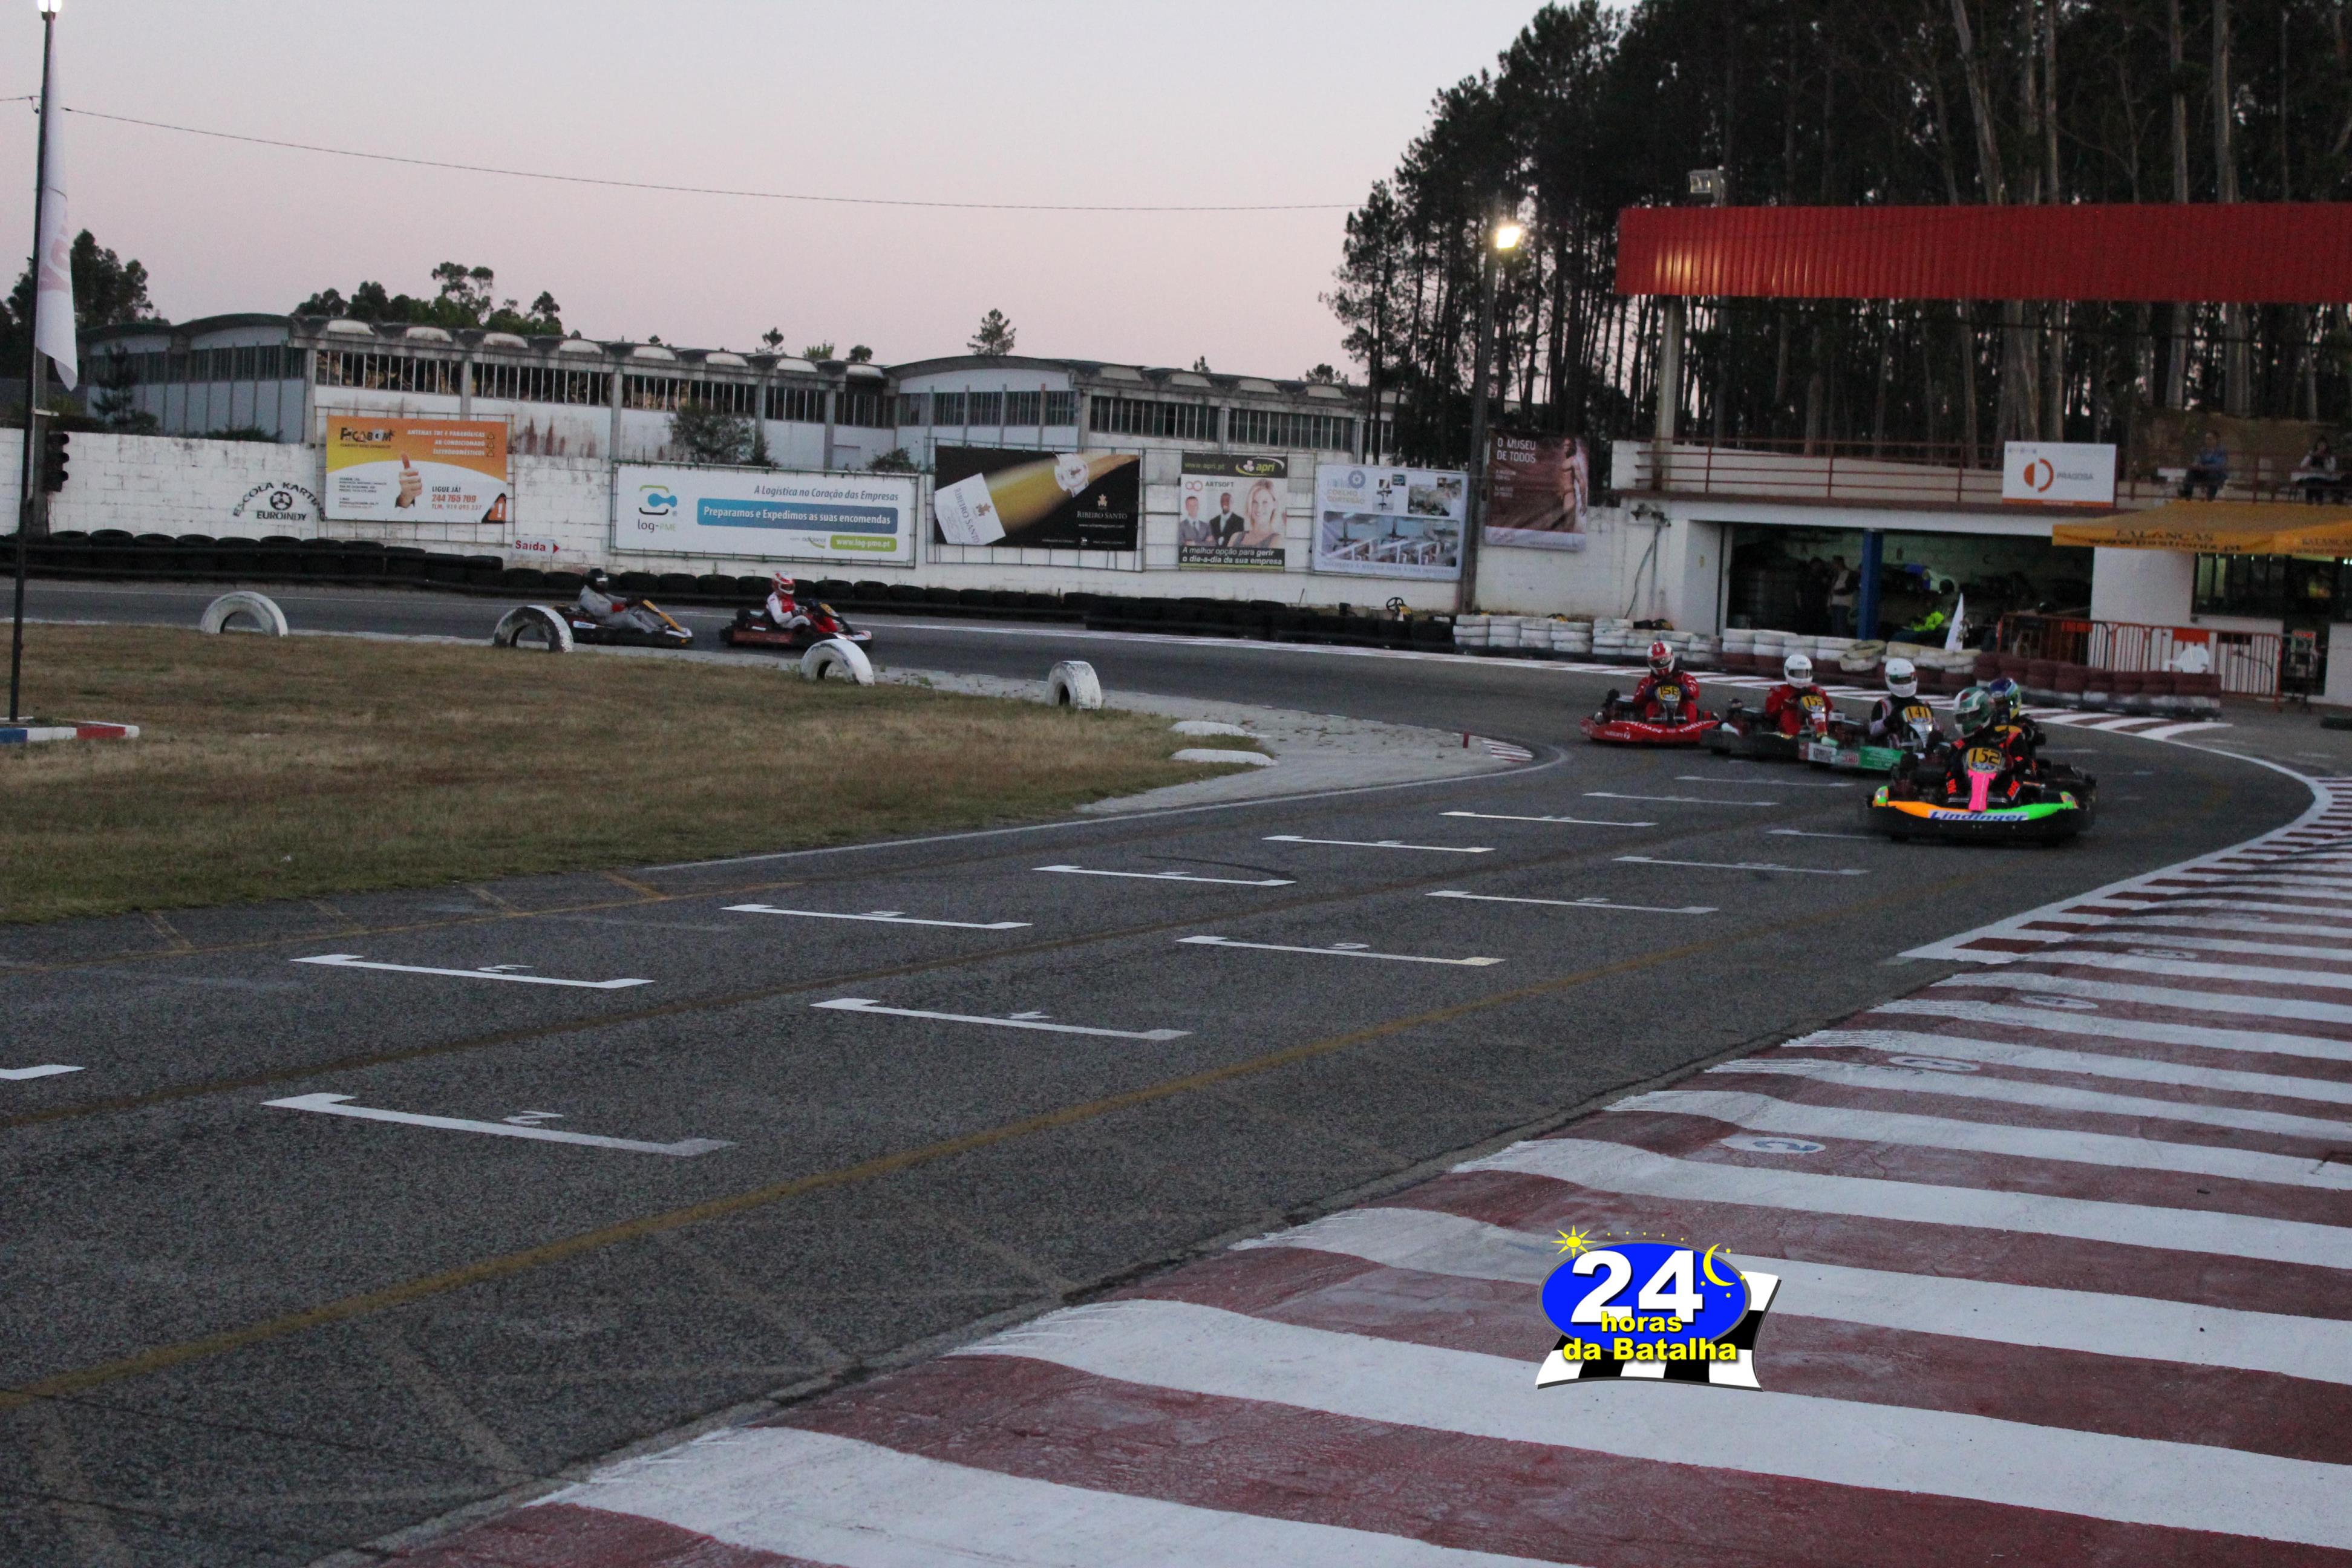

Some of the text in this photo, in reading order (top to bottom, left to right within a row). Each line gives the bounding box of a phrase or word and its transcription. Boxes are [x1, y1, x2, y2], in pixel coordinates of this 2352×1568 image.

[1497, 437, 1536, 450] O MUSEU
[1497, 450, 1536, 463] DE TODOS
[1184, 462, 1225, 471] www.apri.pt
[1256, 462, 1275, 473] apri
[233, 482, 274, 517] ESCOLA
[431, 494, 445, 502] 244
[811, 488, 843, 500] Coração
[844, 490, 858, 499] das
[860, 491, 898, 501] Empresas
[256, 511, 307, 521] EUROINDY
[704, 506, 754, 518] Preparamos
[763, 509, 808, 521] Expedimos
[839, 515, 891, 524] encomendas
[836, 538, 891, 547] www.log-pme.pt
[1907, 707, 1928, 718] 141
[1971, 748, 2001, 765] 152
[1930, 811, 2027, 821] Lindinger
